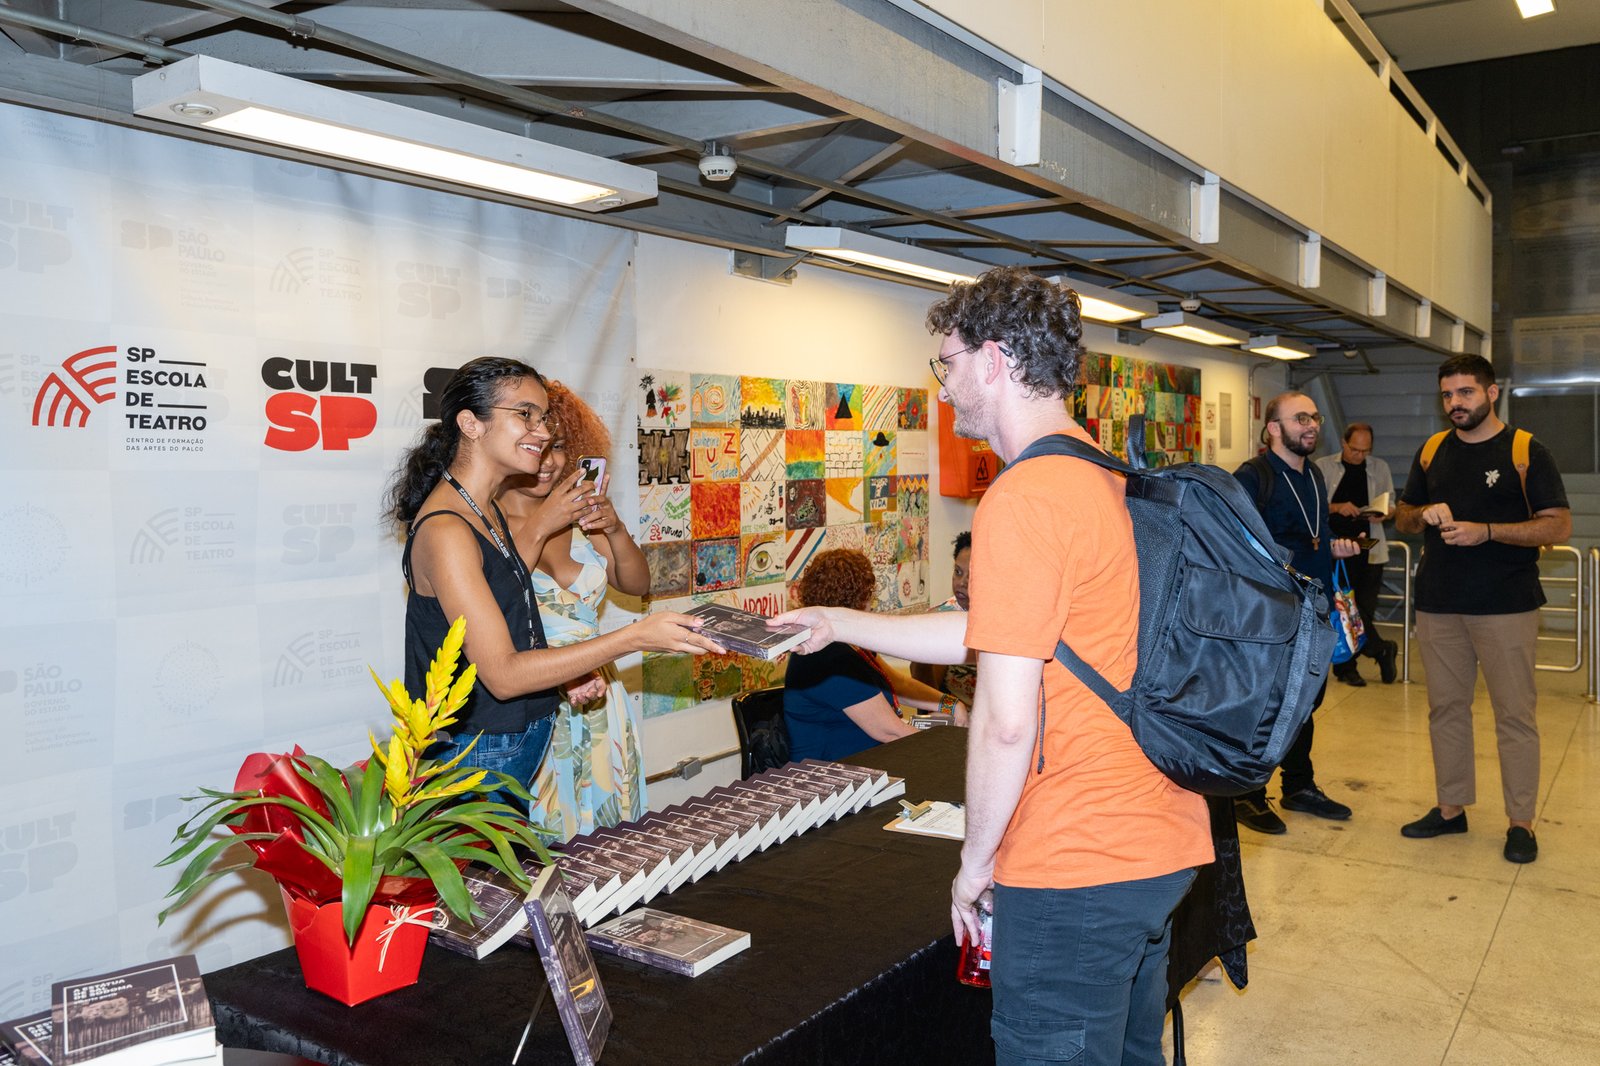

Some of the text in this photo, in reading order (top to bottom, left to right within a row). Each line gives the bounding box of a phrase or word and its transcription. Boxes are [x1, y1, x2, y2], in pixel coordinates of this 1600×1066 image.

[126, 346, 156, 363] SP
[126, 369, 208, 389] ESCOLA
[261, 356, 378, 394] CULT
[125, 391, 154, 408] DE
[125, 414, 208, 432] TEATRO
[263, 392, 379, 452] SP
[167, 437, 204, 445] FORMAÇÃO
[184, 506, 203, 518] SP
[282, 503, 357, 526] CULT
[184, 520, 235, 532] ESCOLA
[184, 535, 201, 546] DE
[280, 525, 356, 566] SP
[185, 548, 235, 561] TEATRO
[318, 639, 361, 653] ESCOLA
[23, 662, 62, 682] SÃO
[320, 664, 363, 680] TEATRO
[23, 678, 83, 698] PAULO
[0, 810, 77, 851] ULT
